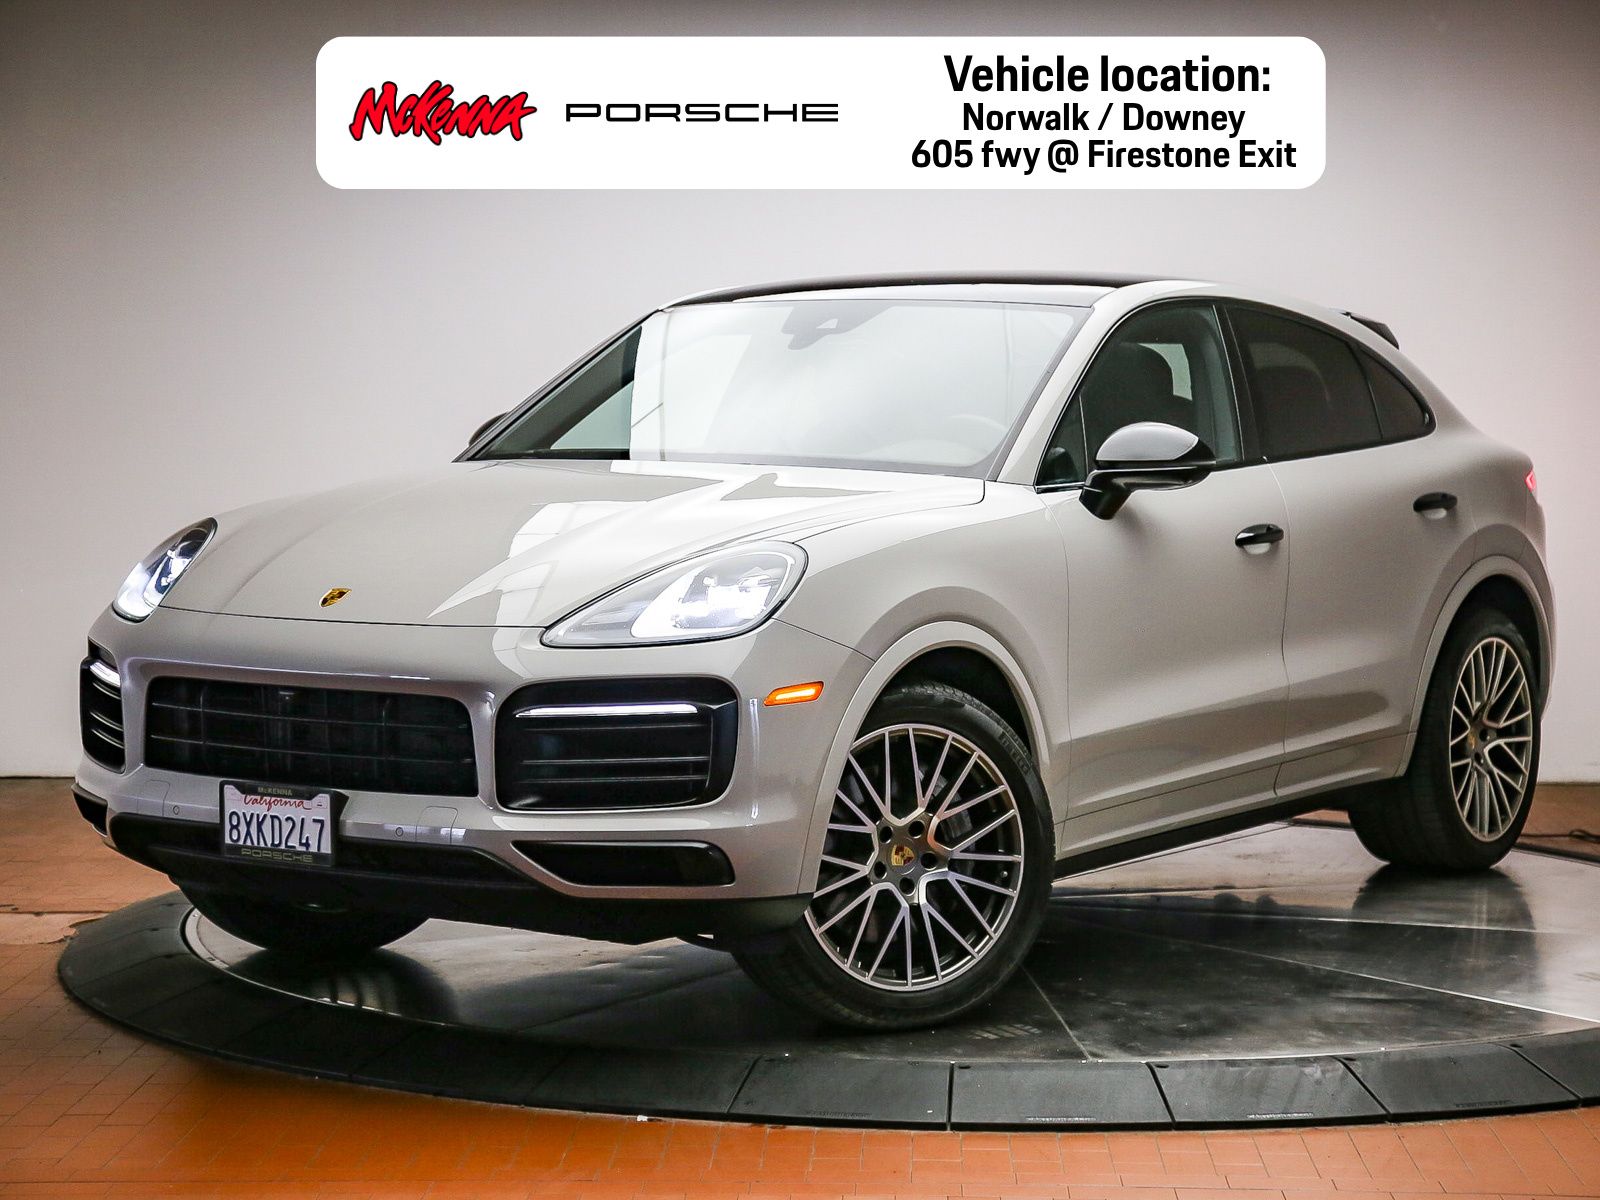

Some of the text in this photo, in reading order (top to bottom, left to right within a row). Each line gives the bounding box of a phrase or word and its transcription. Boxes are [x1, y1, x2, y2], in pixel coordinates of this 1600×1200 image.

[243, 794, 312, 812] California
[228, 810, 325, 852] 8XKD247
[241, 848, 313, 863] PORSCHE
